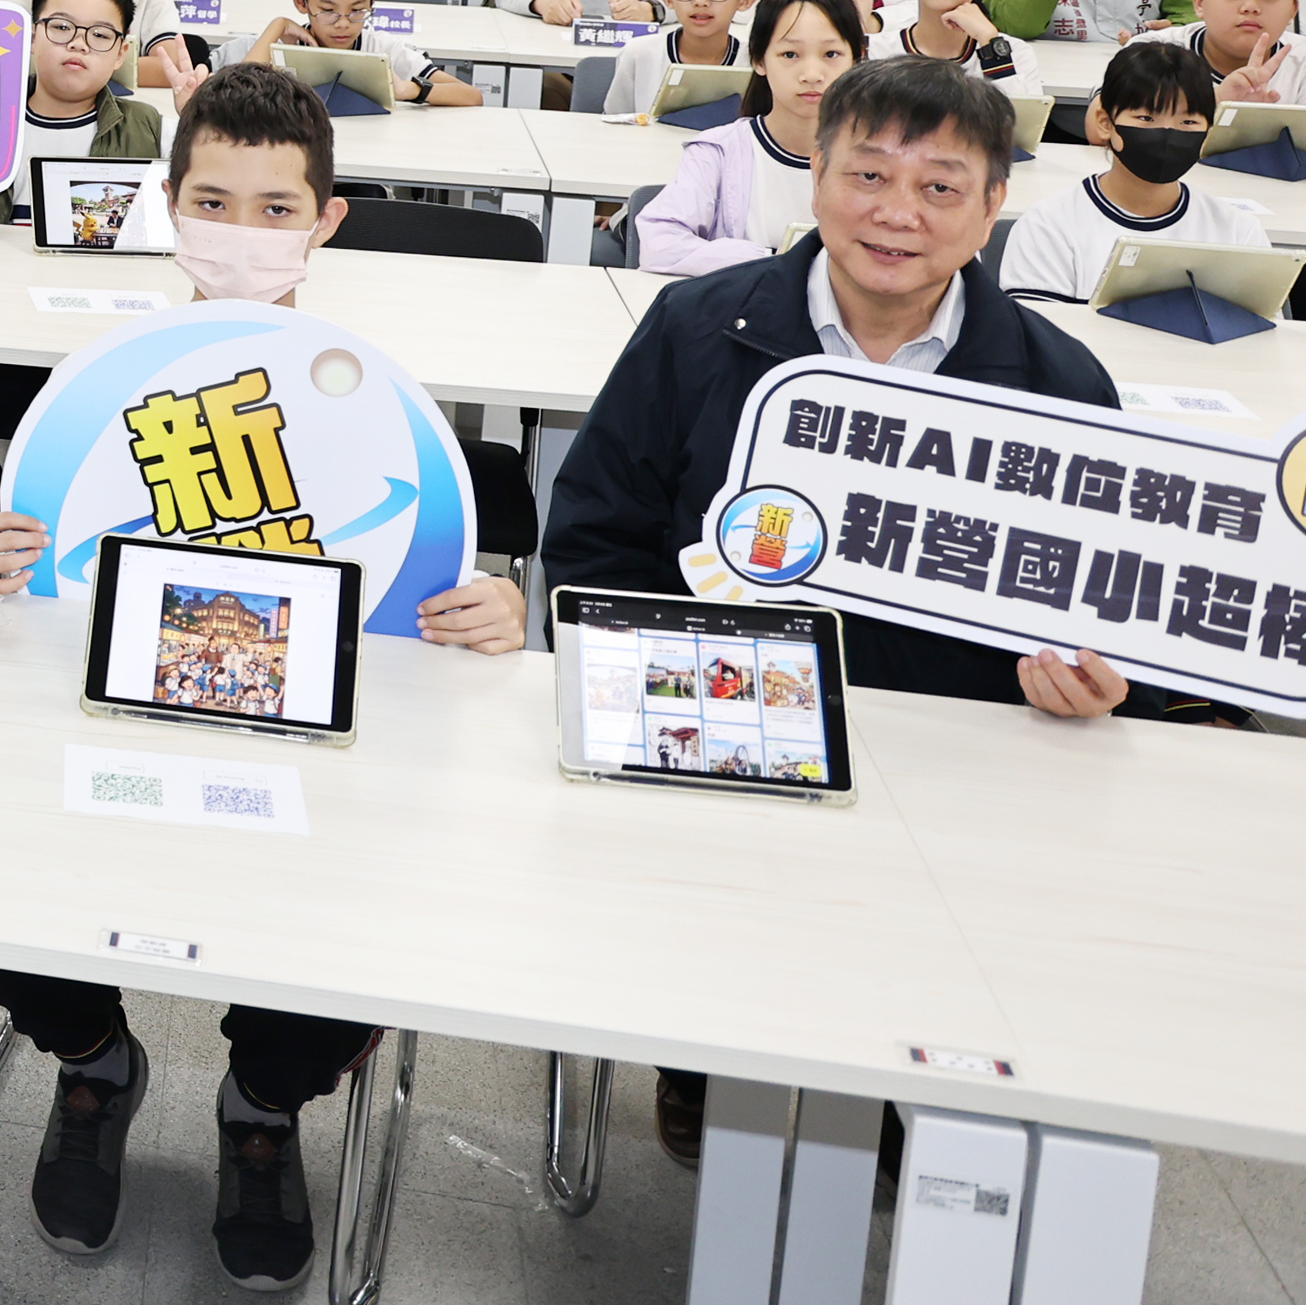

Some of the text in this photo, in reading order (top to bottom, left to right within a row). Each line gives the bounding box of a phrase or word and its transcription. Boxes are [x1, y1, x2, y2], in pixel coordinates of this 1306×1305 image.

[782, 397, 1268, 545] 創新AI數位教育
[749, 502, 794, 570] 新營
